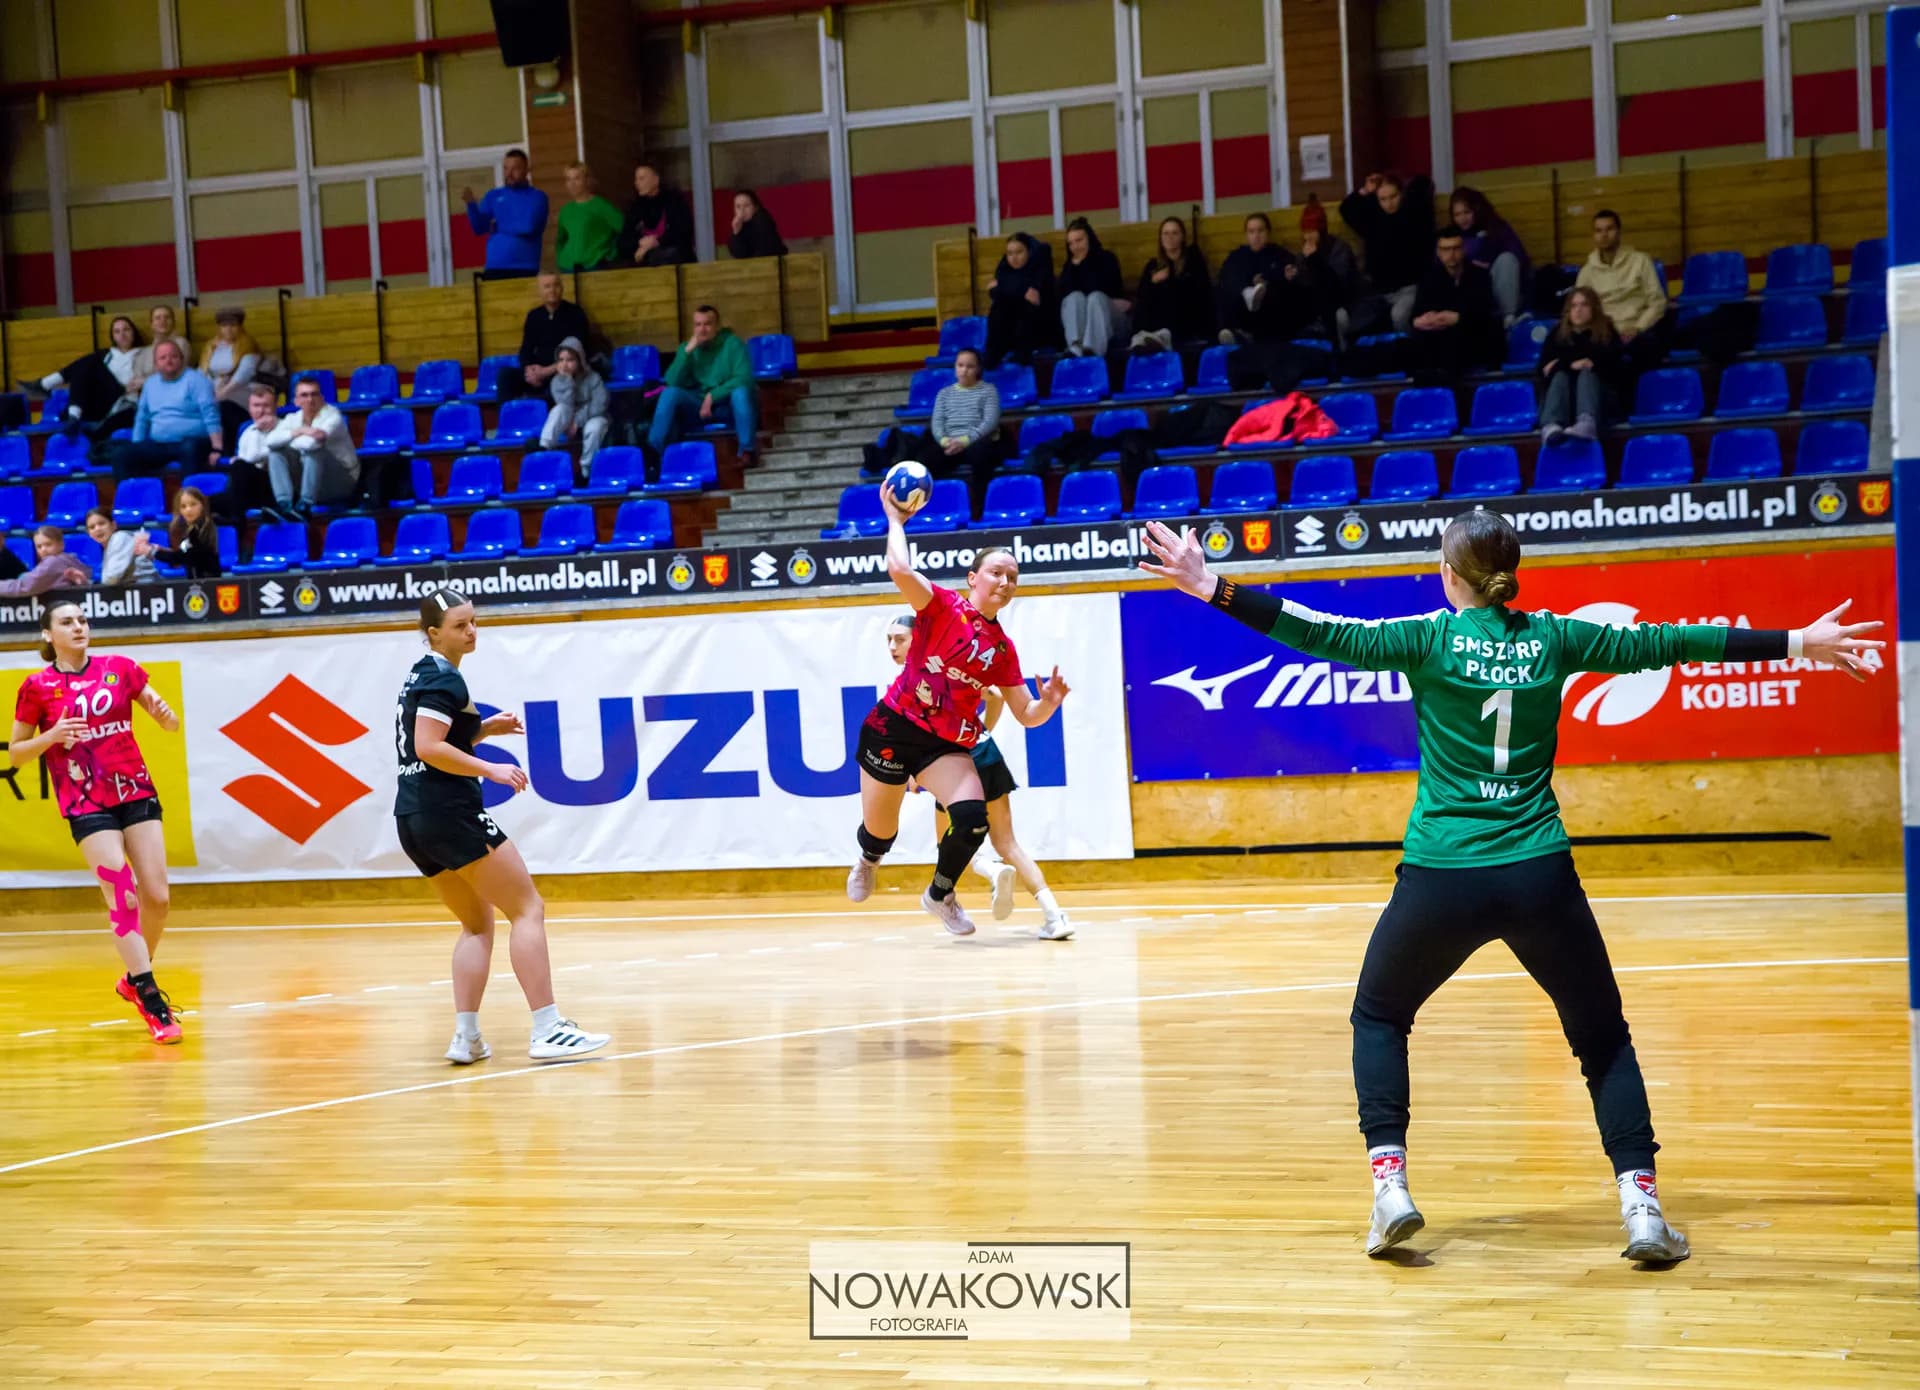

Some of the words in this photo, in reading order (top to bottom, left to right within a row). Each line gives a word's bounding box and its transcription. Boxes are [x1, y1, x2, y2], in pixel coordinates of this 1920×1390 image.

[0, 588, 175, 623] nahdball.pl
[966, 639, 996, 671] 14
[1679, 647, 1884, 678] CENTRALA
[1466, 659, 1533, 684] PŁOCK
[75, 688, 112, 720] 10
[1681, 679, 1801, 710] KOBIET
[1481, 689, 1513, 774] 1
